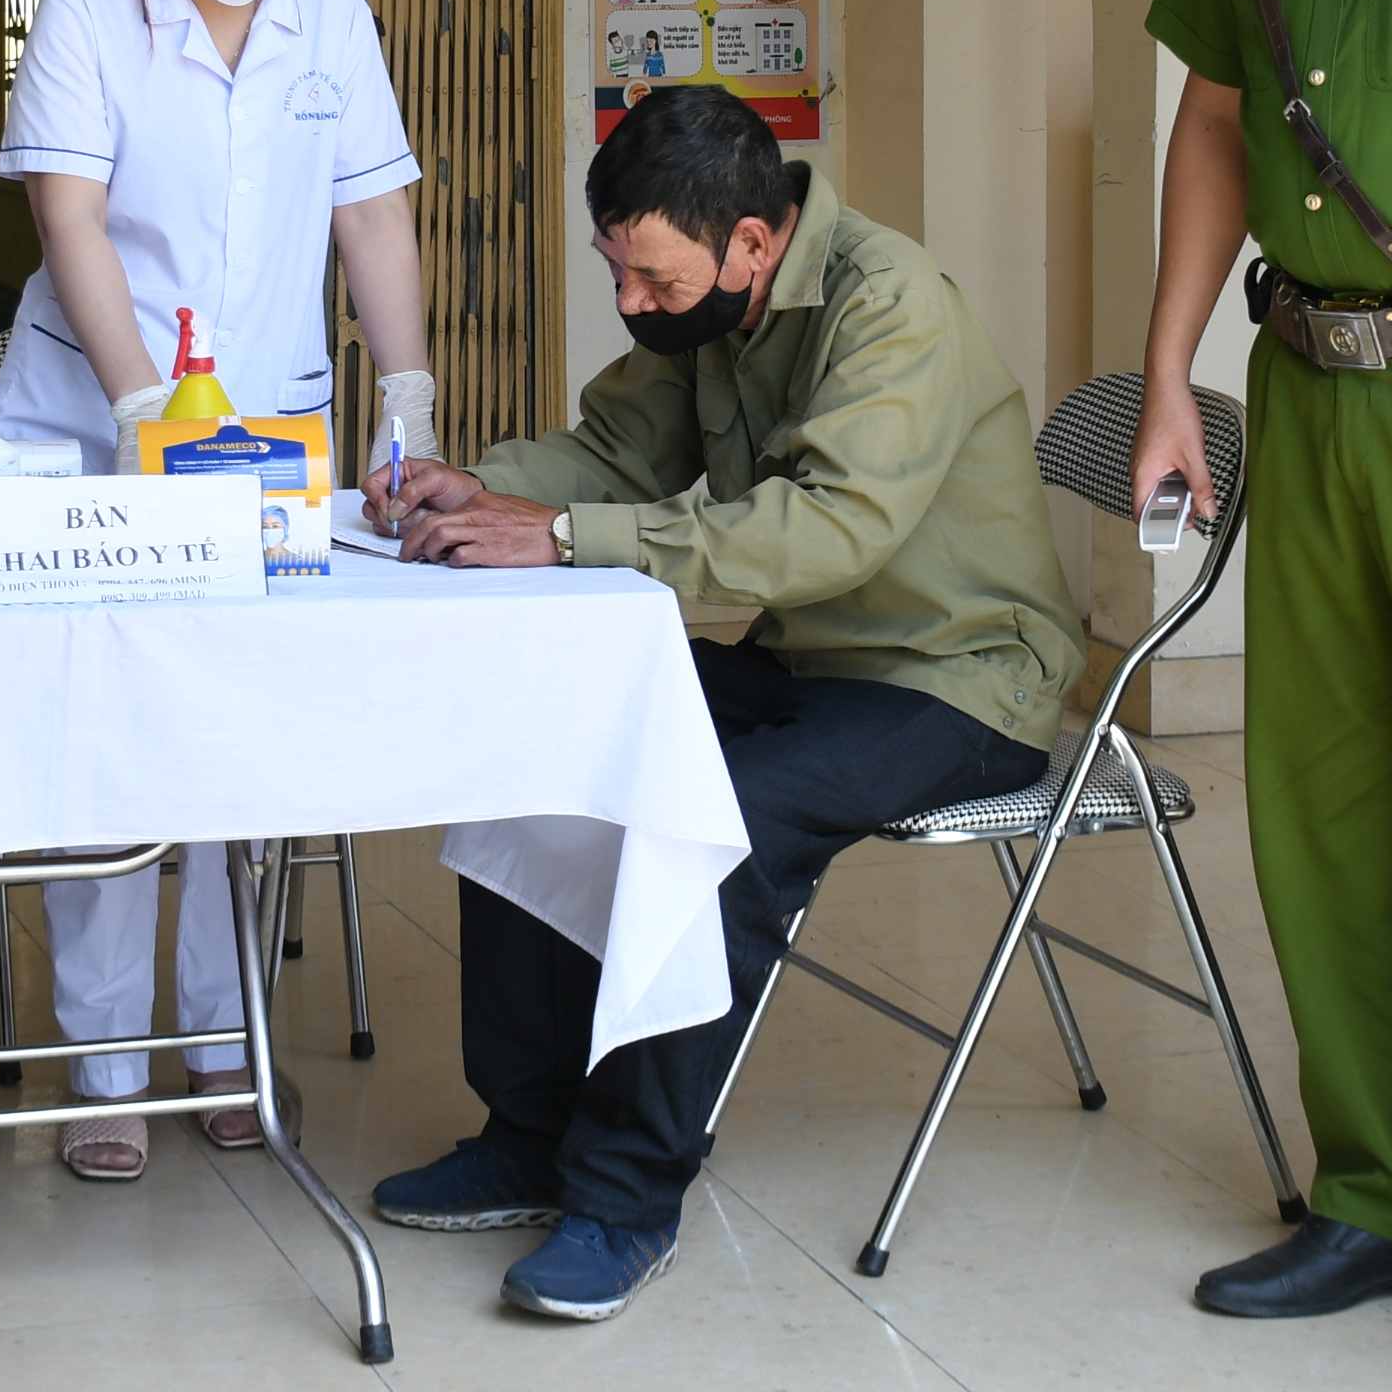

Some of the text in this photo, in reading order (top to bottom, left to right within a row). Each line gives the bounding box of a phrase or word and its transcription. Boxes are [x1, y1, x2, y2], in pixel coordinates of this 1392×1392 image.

[765, 114, 792, 123] PHÒNG
[196, 442, 256, 451] DANAMECO
[65, 500, 129, 531] BÀN
[71, 542, 140, 570] BÁO
[148, 545, 171, 566] Y
[177, 537, 220, 564] TẾ
[8, 580, 38, 592] ĐIỆN
[41, 580, 80, 590] THOẠI
[170, 575, 211, 585] (MINH)
